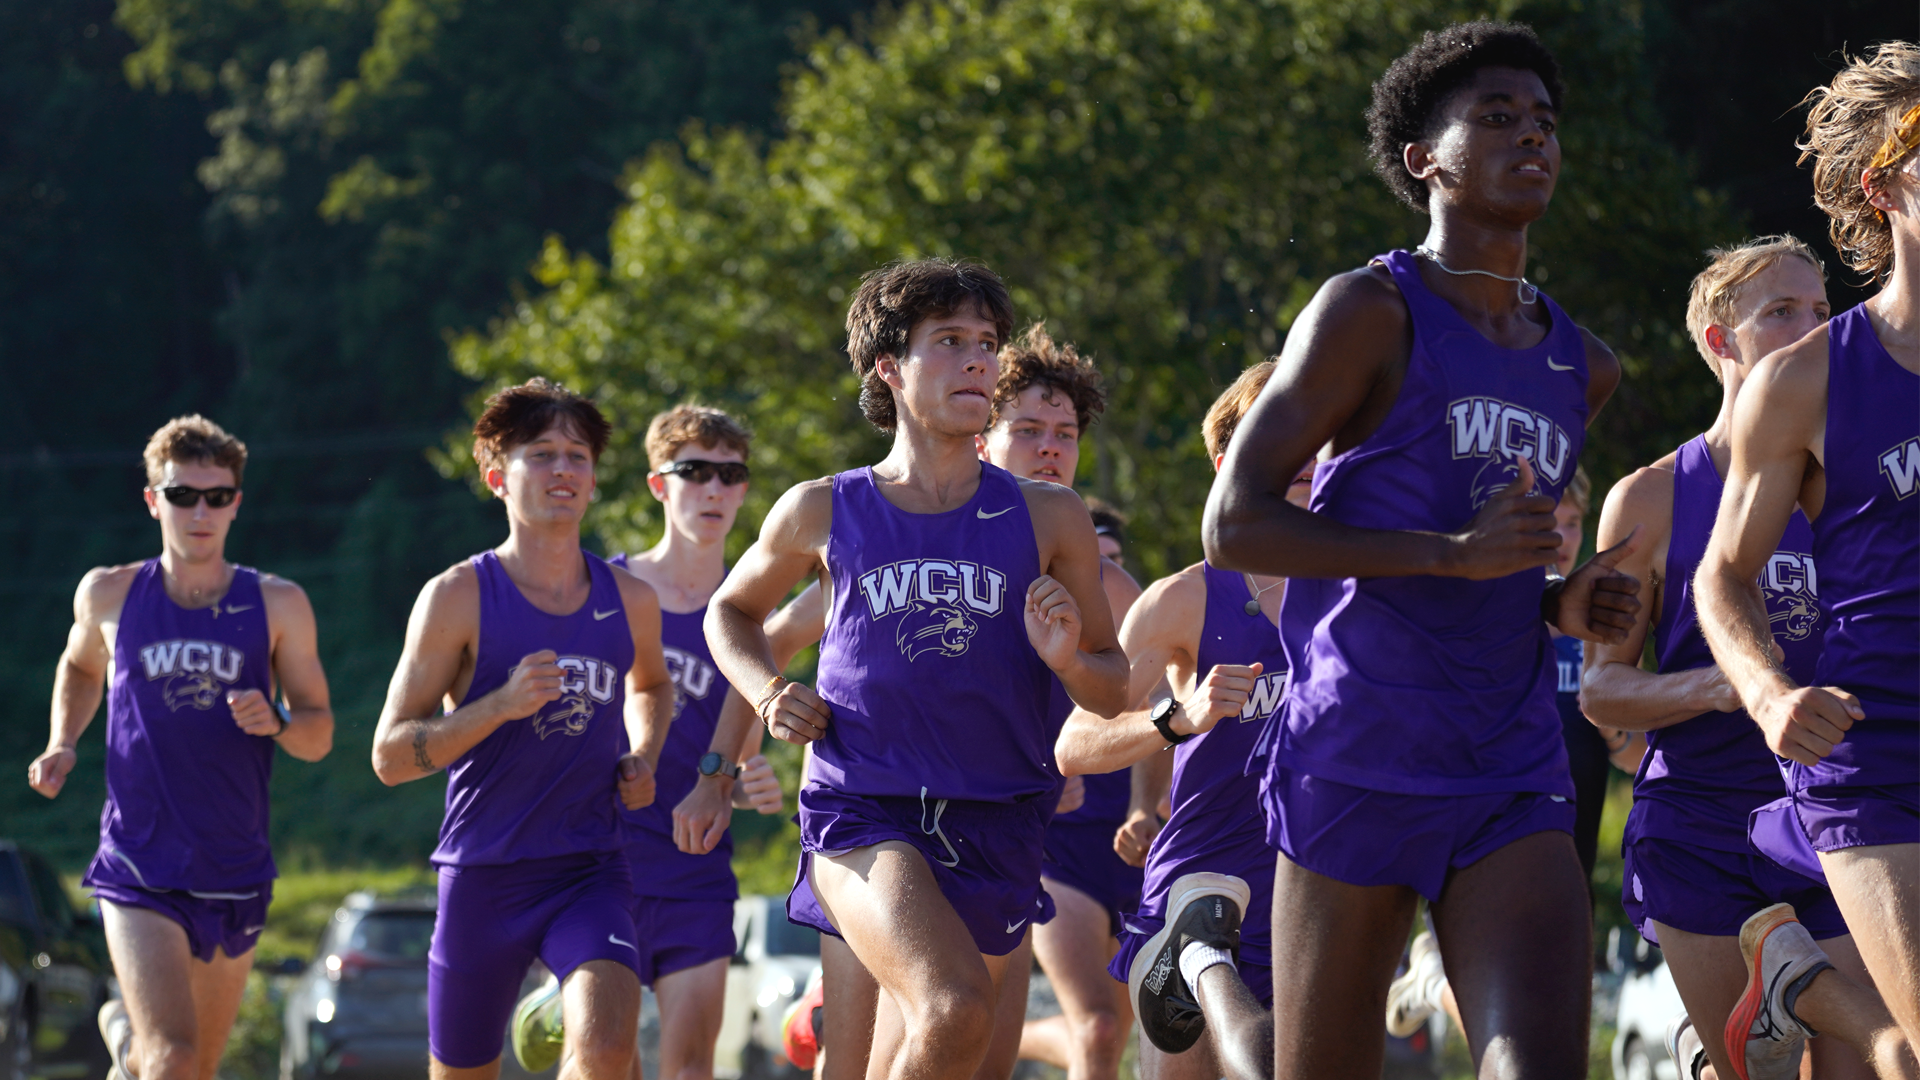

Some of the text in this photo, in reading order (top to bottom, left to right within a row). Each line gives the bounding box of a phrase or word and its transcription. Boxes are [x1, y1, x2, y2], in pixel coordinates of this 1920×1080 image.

[1446, 396, 1570, 486] WCU
[858, 558, 1006, 621] WCU
[138, 639, 244, 685] WCU
